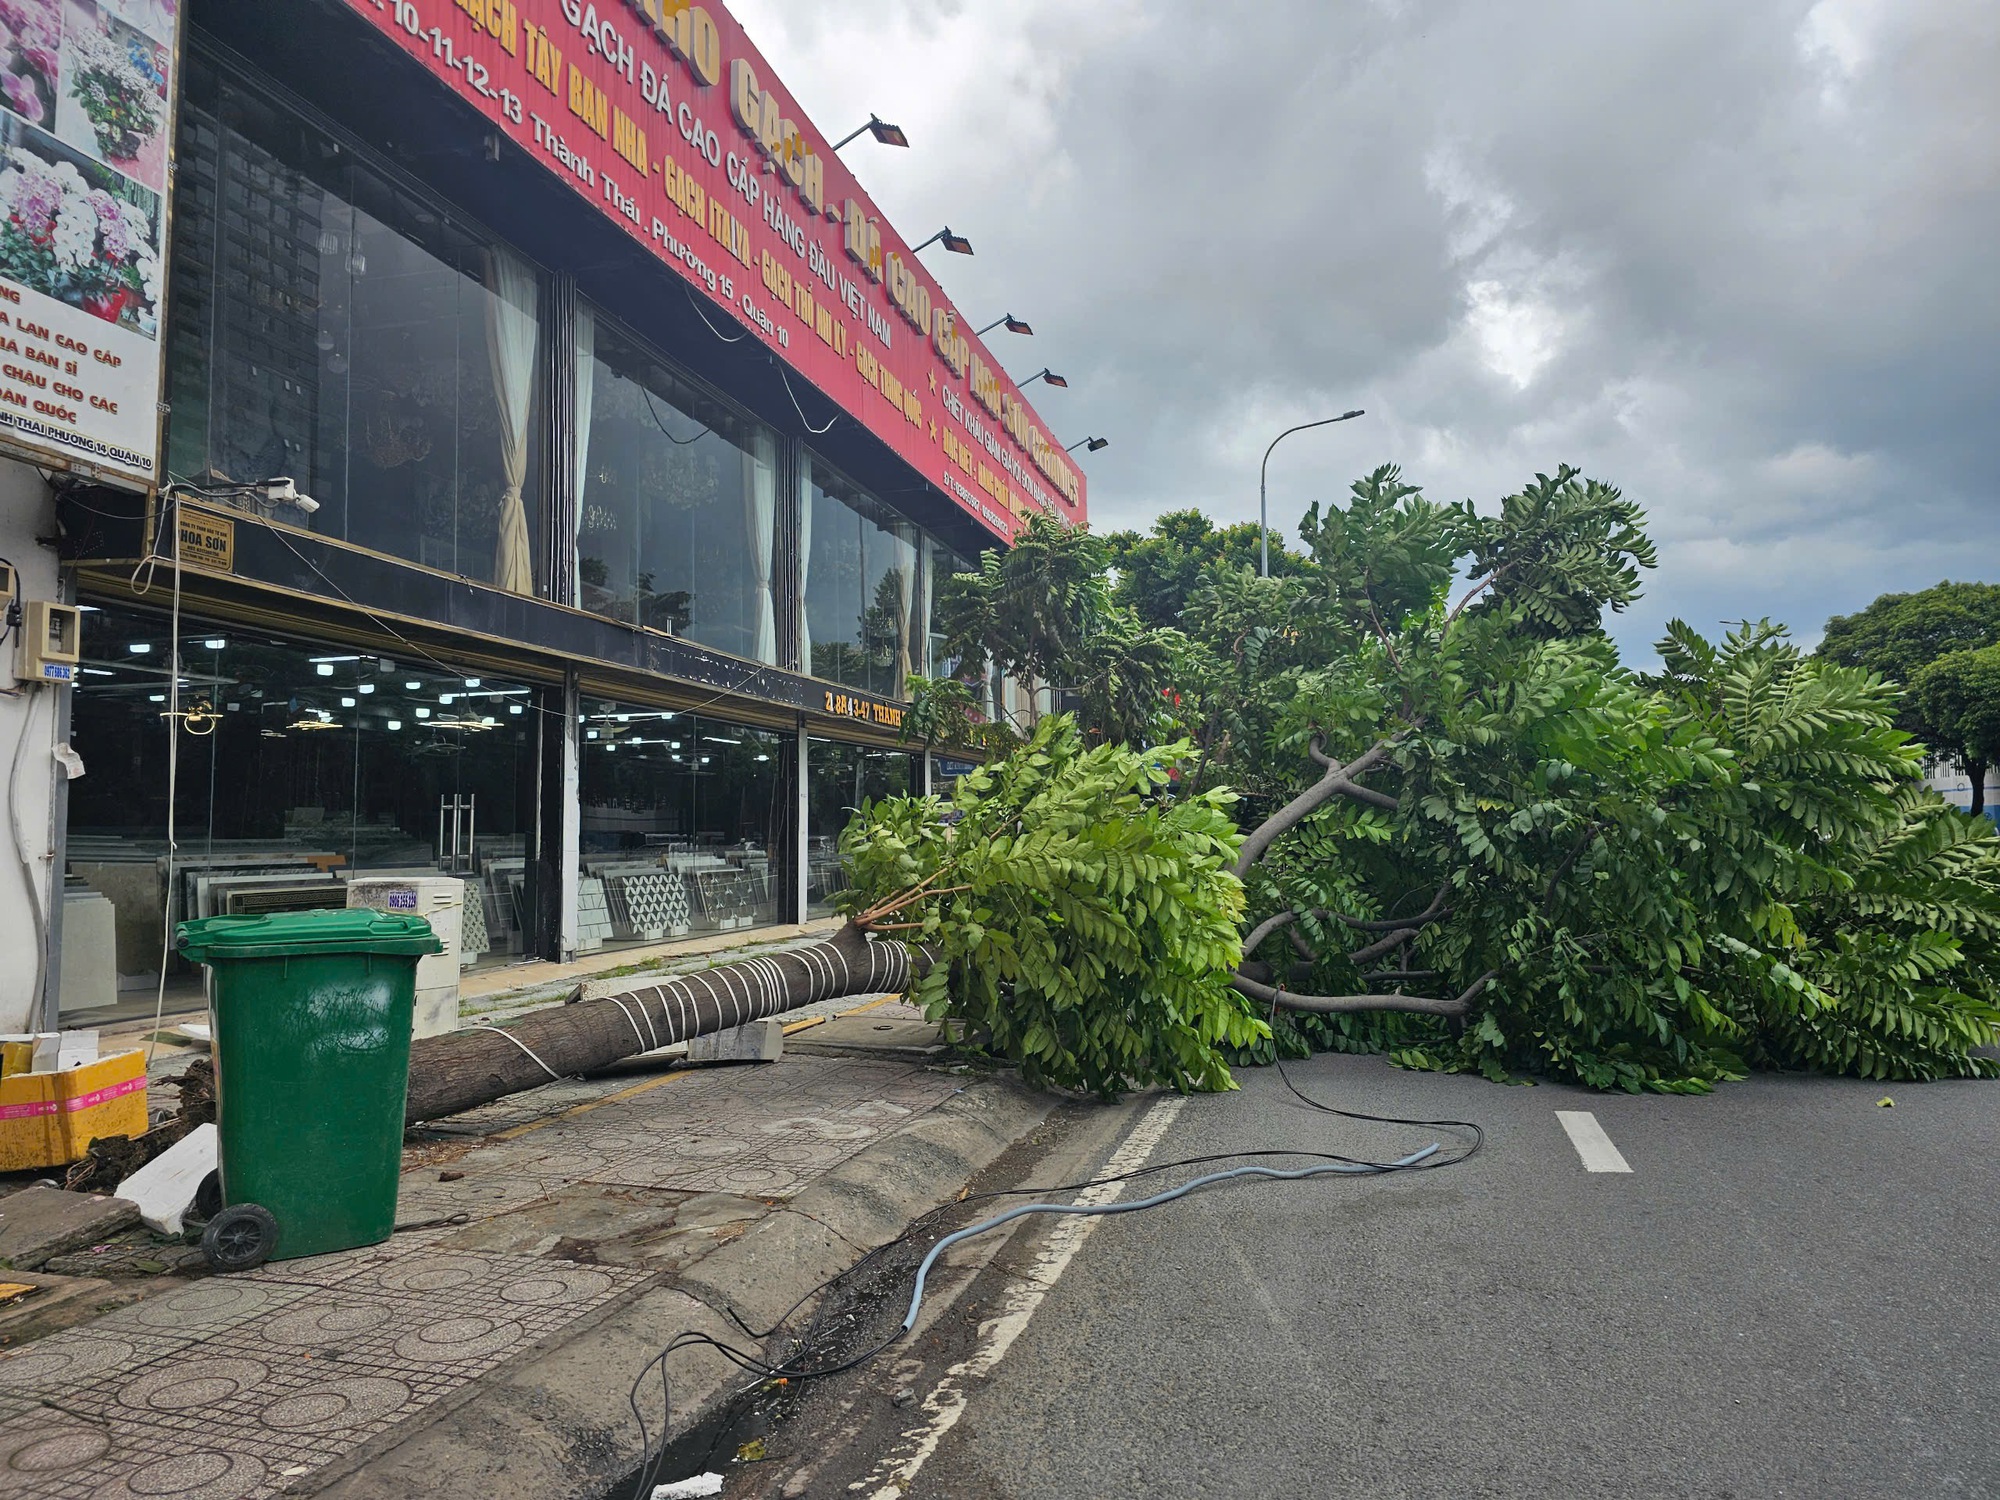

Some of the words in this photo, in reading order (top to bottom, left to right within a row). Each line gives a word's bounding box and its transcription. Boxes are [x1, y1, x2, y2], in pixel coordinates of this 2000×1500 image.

[453, 0, 516, 58] ẠCH
[523, 18, 562, 96] TÂY
[567, 62, 608, 141] BAN
[612, 104, 648, 178] NHA
[664, 154, 705, 229] GẠCH
[761, 247, 791, 309] GẠCH
[388, 0, 523, 124] 10-11-12-13
[529, 111, 594, 187] Thành
[600, 172, 641, 225] Thái
[652, 216, 716, 292] Phường
[719, 273, 734, 300] 15
[741, 294, 774, 336] Quận
[776, 325, 789, 348] 10
[562, 0, 633, 84] GẠCH
[640, 60, 673, 124] ĐÁ
[678, 102, 721, 167] CAO
[727, 151, 760, 206] CẤP
[762, 189, 805, 258] HÀNG
[808, 239, 836, 291] ĐẦU
[838, 271, 866, 320] VIỆT
[867, 302, 891, 349] NAM
[731, 58, 823, 216] GẠCH
[886, 252, 931, 336] CAO
[16, 317, 50, 341] LAN
[55, 333, 88, 355] CAO
[25, 346, 59, 370] BÁN
[0, 387, 27, 408] ÀN
[33, 399, 77, 425] QUỐC
[53, 381, 84, 402] CHO
[89, 395, 118, 415] CÁC
[96, 442, 108, 454] 14
[109, 446, 140, 466] QUẬN
[141, 456, 153, 469] 10
[180, 528, 203, 547] HOA
[205, 535, 227, 553] SƠN
